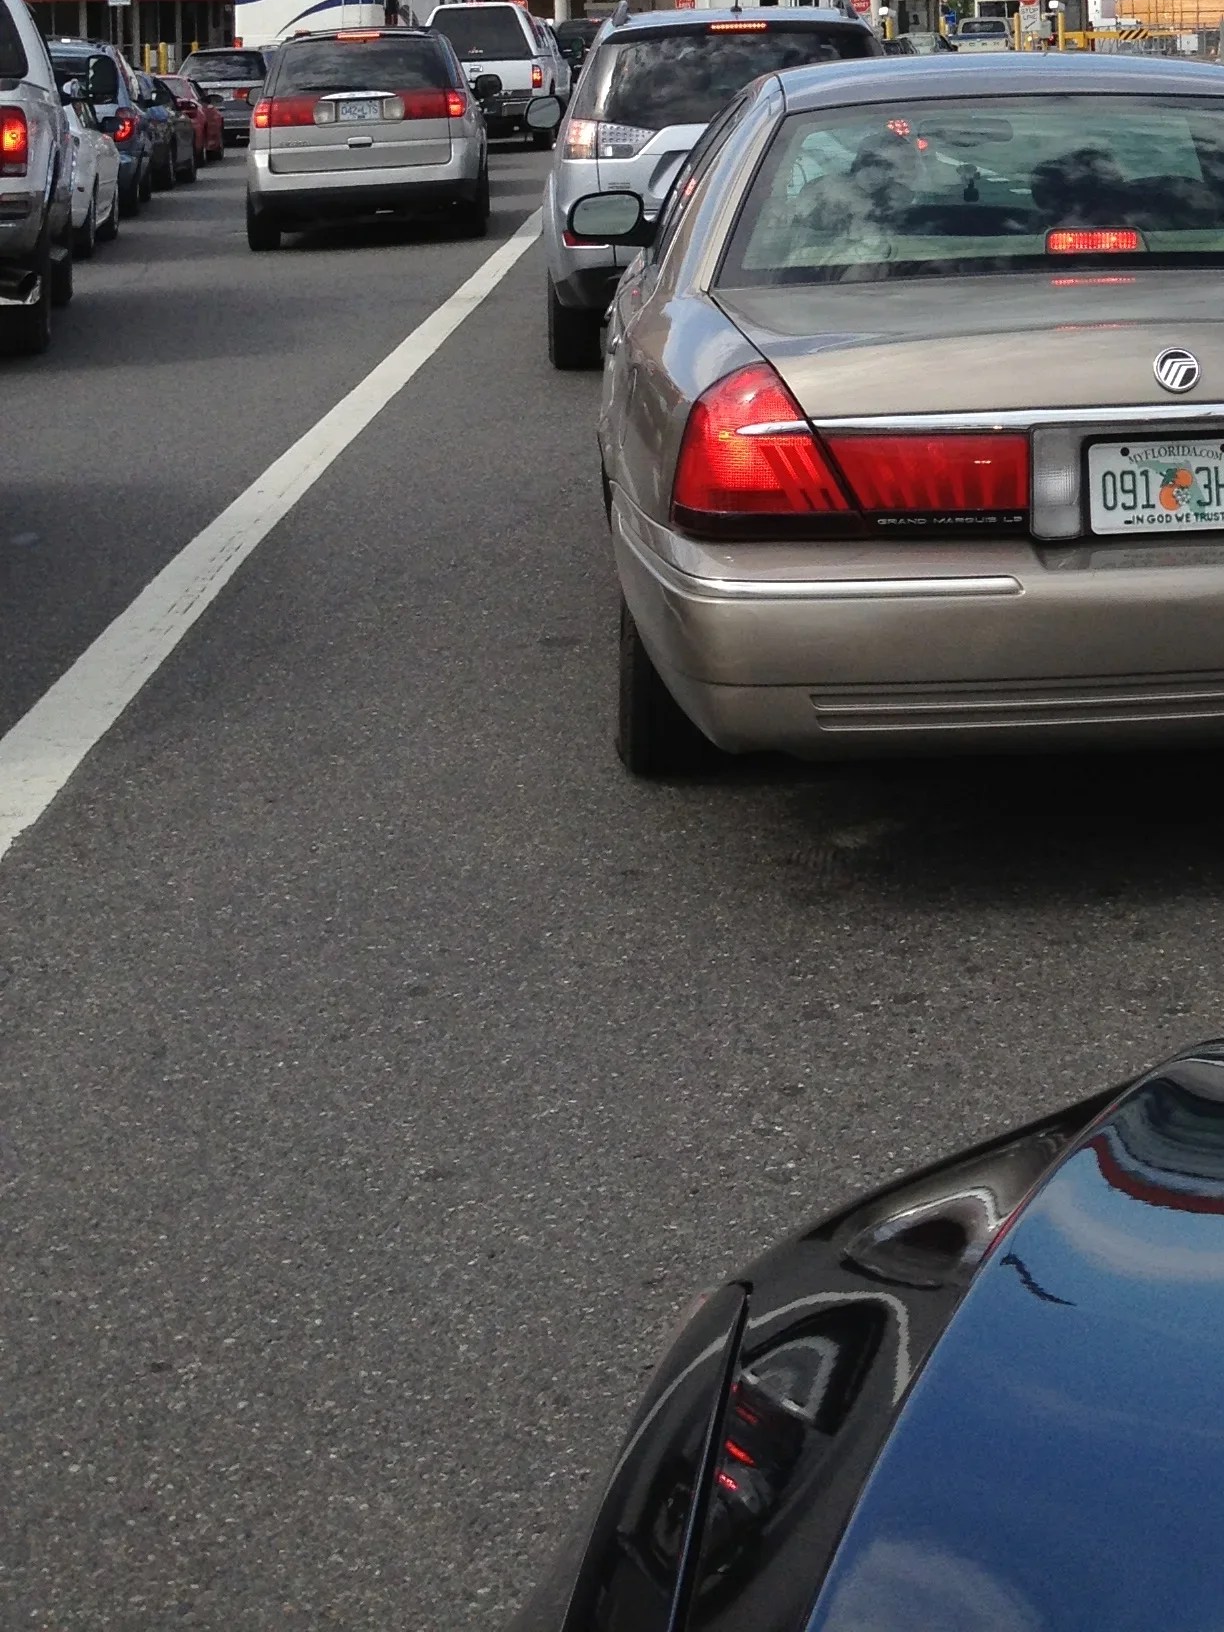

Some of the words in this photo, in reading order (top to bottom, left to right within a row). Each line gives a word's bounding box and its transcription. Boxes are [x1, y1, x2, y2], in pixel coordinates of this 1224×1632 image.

[1128, 445, 1223, 465] MYFLORIDA.COM
[1101, 468, 1156, 511] 091
[877, 517, 927, 525] GRAND
[933, 516, 997, 524] MARQUIS
[1003, 515, 1023, 523] LS
[1131, 514, 1145, 525] IN
[1147, 513, 1172, 524] GOD
[1175, 513, 1191, 523] WE
